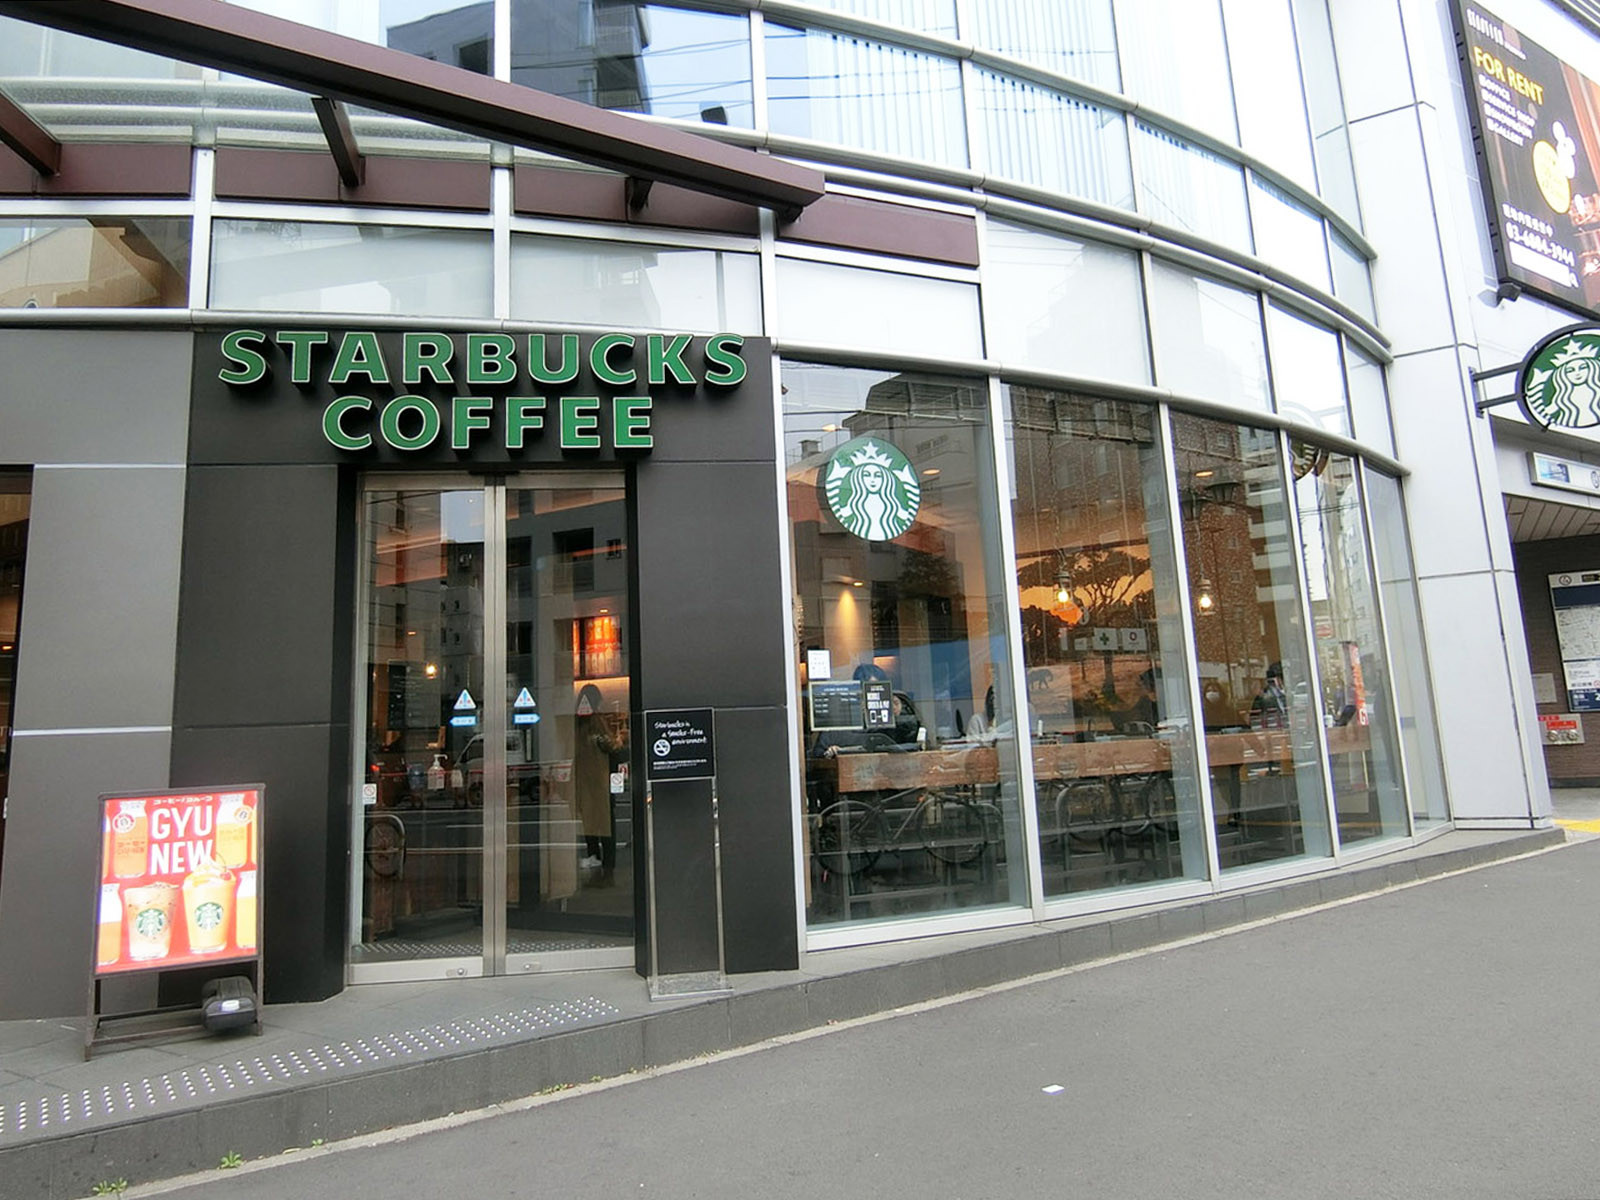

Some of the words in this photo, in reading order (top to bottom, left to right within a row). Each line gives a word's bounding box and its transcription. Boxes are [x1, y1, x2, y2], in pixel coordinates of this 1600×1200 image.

[1474, 46, 1506, 82] FOR
[1506, 67, 1544, 105] RENT
[218, 329, 748, 387] STARBUCKS
[322, 394, 654, 450] COFFEE
[654, 720, 684, 729] Starbucks
[671, 736, 707, 745] environment
[152, 804, 213, 840] GYU
[150, 839, 213, 876] NEW
